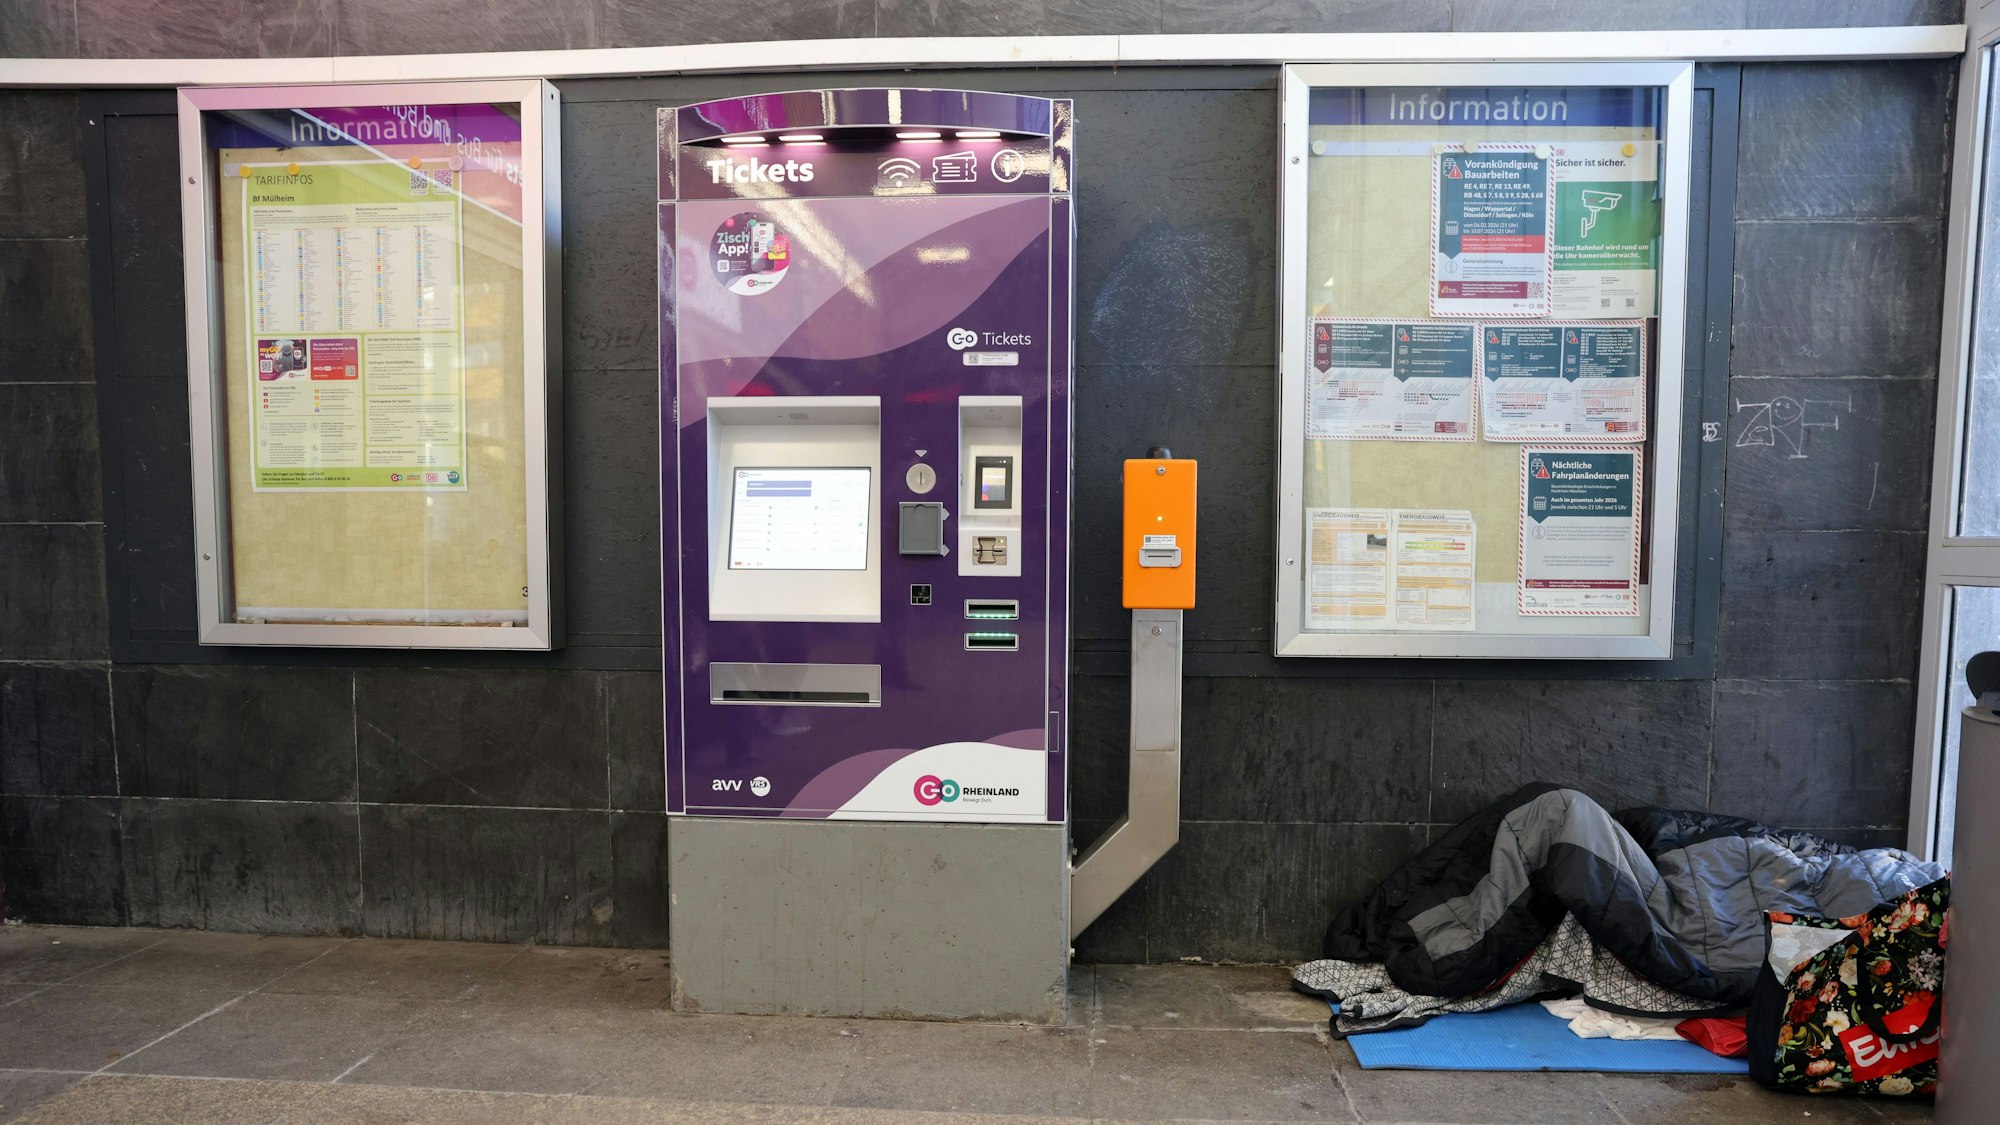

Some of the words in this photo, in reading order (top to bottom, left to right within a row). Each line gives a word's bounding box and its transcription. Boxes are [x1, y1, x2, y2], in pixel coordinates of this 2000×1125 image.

[1390, 93, 1568, 121] Information
[291, 115, 451, 143] Information
[1464, 160, 1539, 170] Vorankündigung
[1555, 158, 1583, 167] Sicher
[1584, 158, 1595, 167] ist
[1597, 158, 1626, 167] sicher.
[706, 157, 814, 184] Tickets
[1464, 170, 1520, 179] Bauarbeiten
[254, 174, 314, 186] TARIFINFOS
[252, 195, 261, 203] Bf
[717, 231, 750, 243] Zisch
[718, 243, 749, 257] App!
[982, 331, 1032, 346] Tickets
[1552, 461, 1592, 470] Nächtliche
[1551, 472, 1630, 481] Fahrplanänderungen
[712, 779, 743, 792] avv
[750, 780, 768, 789] VRS
[962, 787, 1020, 796] RHEINLAND
